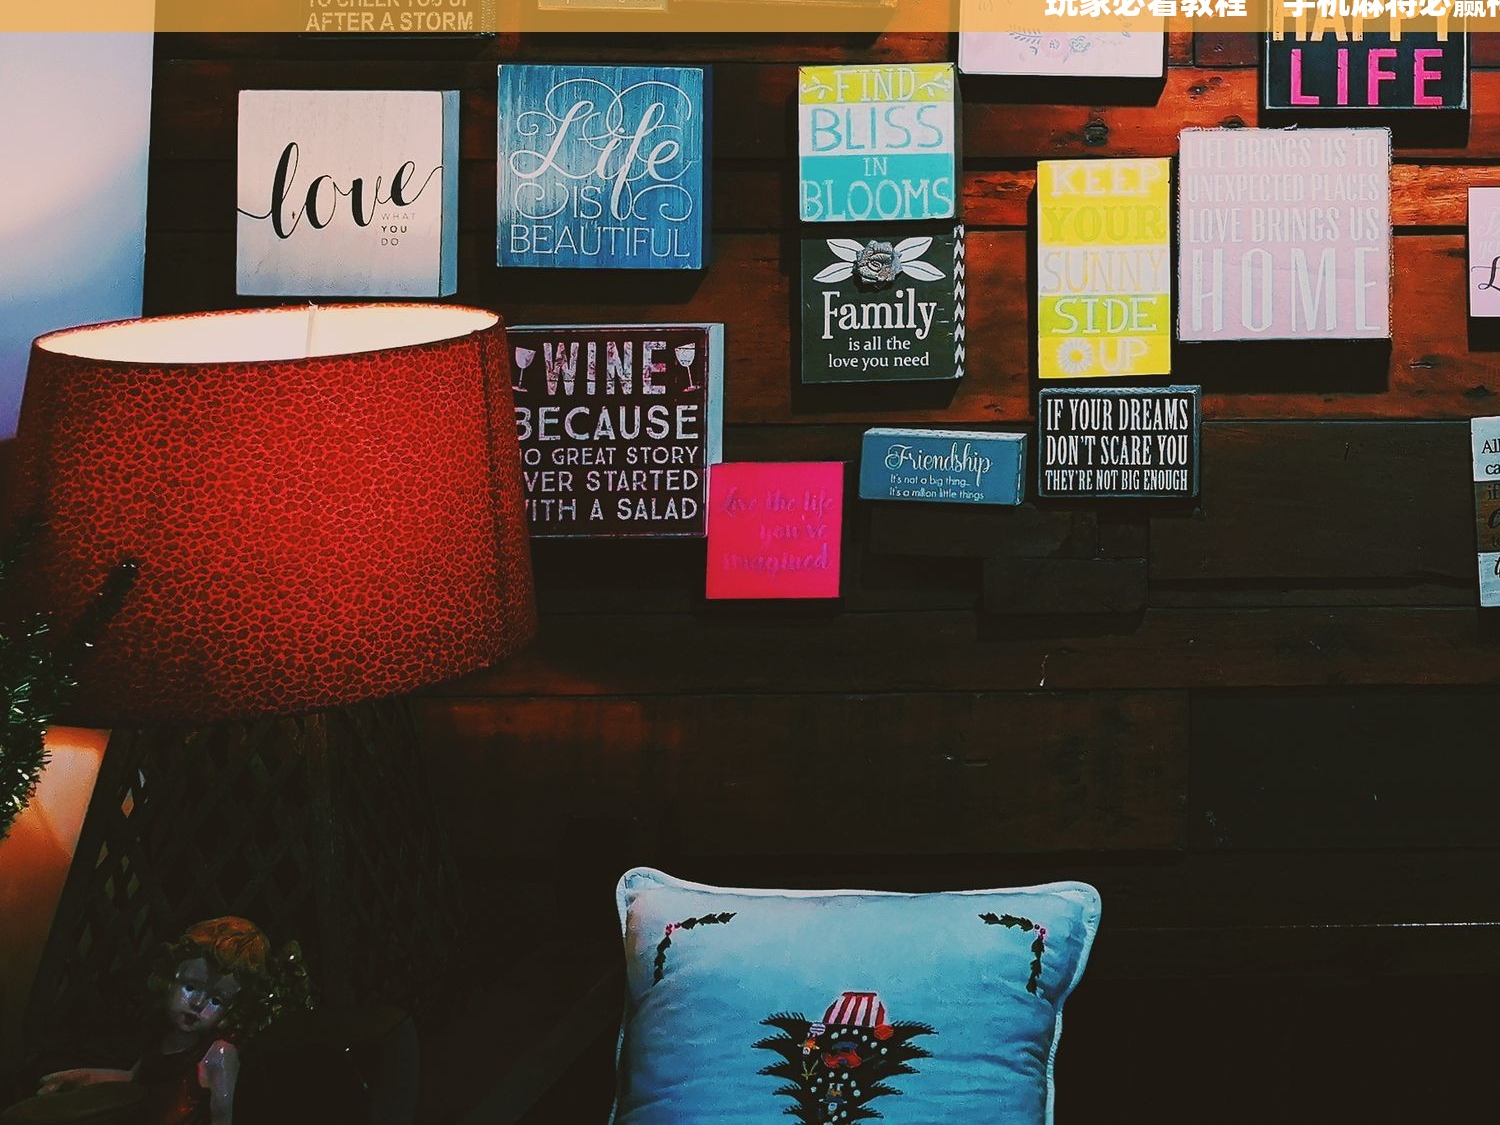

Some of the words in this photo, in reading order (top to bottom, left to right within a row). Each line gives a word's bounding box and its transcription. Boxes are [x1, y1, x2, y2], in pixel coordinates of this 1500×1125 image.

[1290, 48, 1443, 106] LIFE
[810, 105, 943, 152] BLISS
[238, 142, 443, 239] love
[801, 180, 952, 219] BLOOMS
[510, 227, 690, 256] BEAUTIFUL
[821, 289, 937, 339] Family
[542, 341, 667, 395] WINE
[828, 354, 857, 369] love
[862, 356, 890, 372] you
[895, 353, 929, 368] need
[1047, 400, 1062, 431] IF
[1070, 400, 1113, 431] YOUR
[1118, 399, 1188, 431] DREAMS
[551, 446, 617, 467] GREAT
[626, 446, 699, 466] STORY
[885, 442, 992, 479] Friendship
